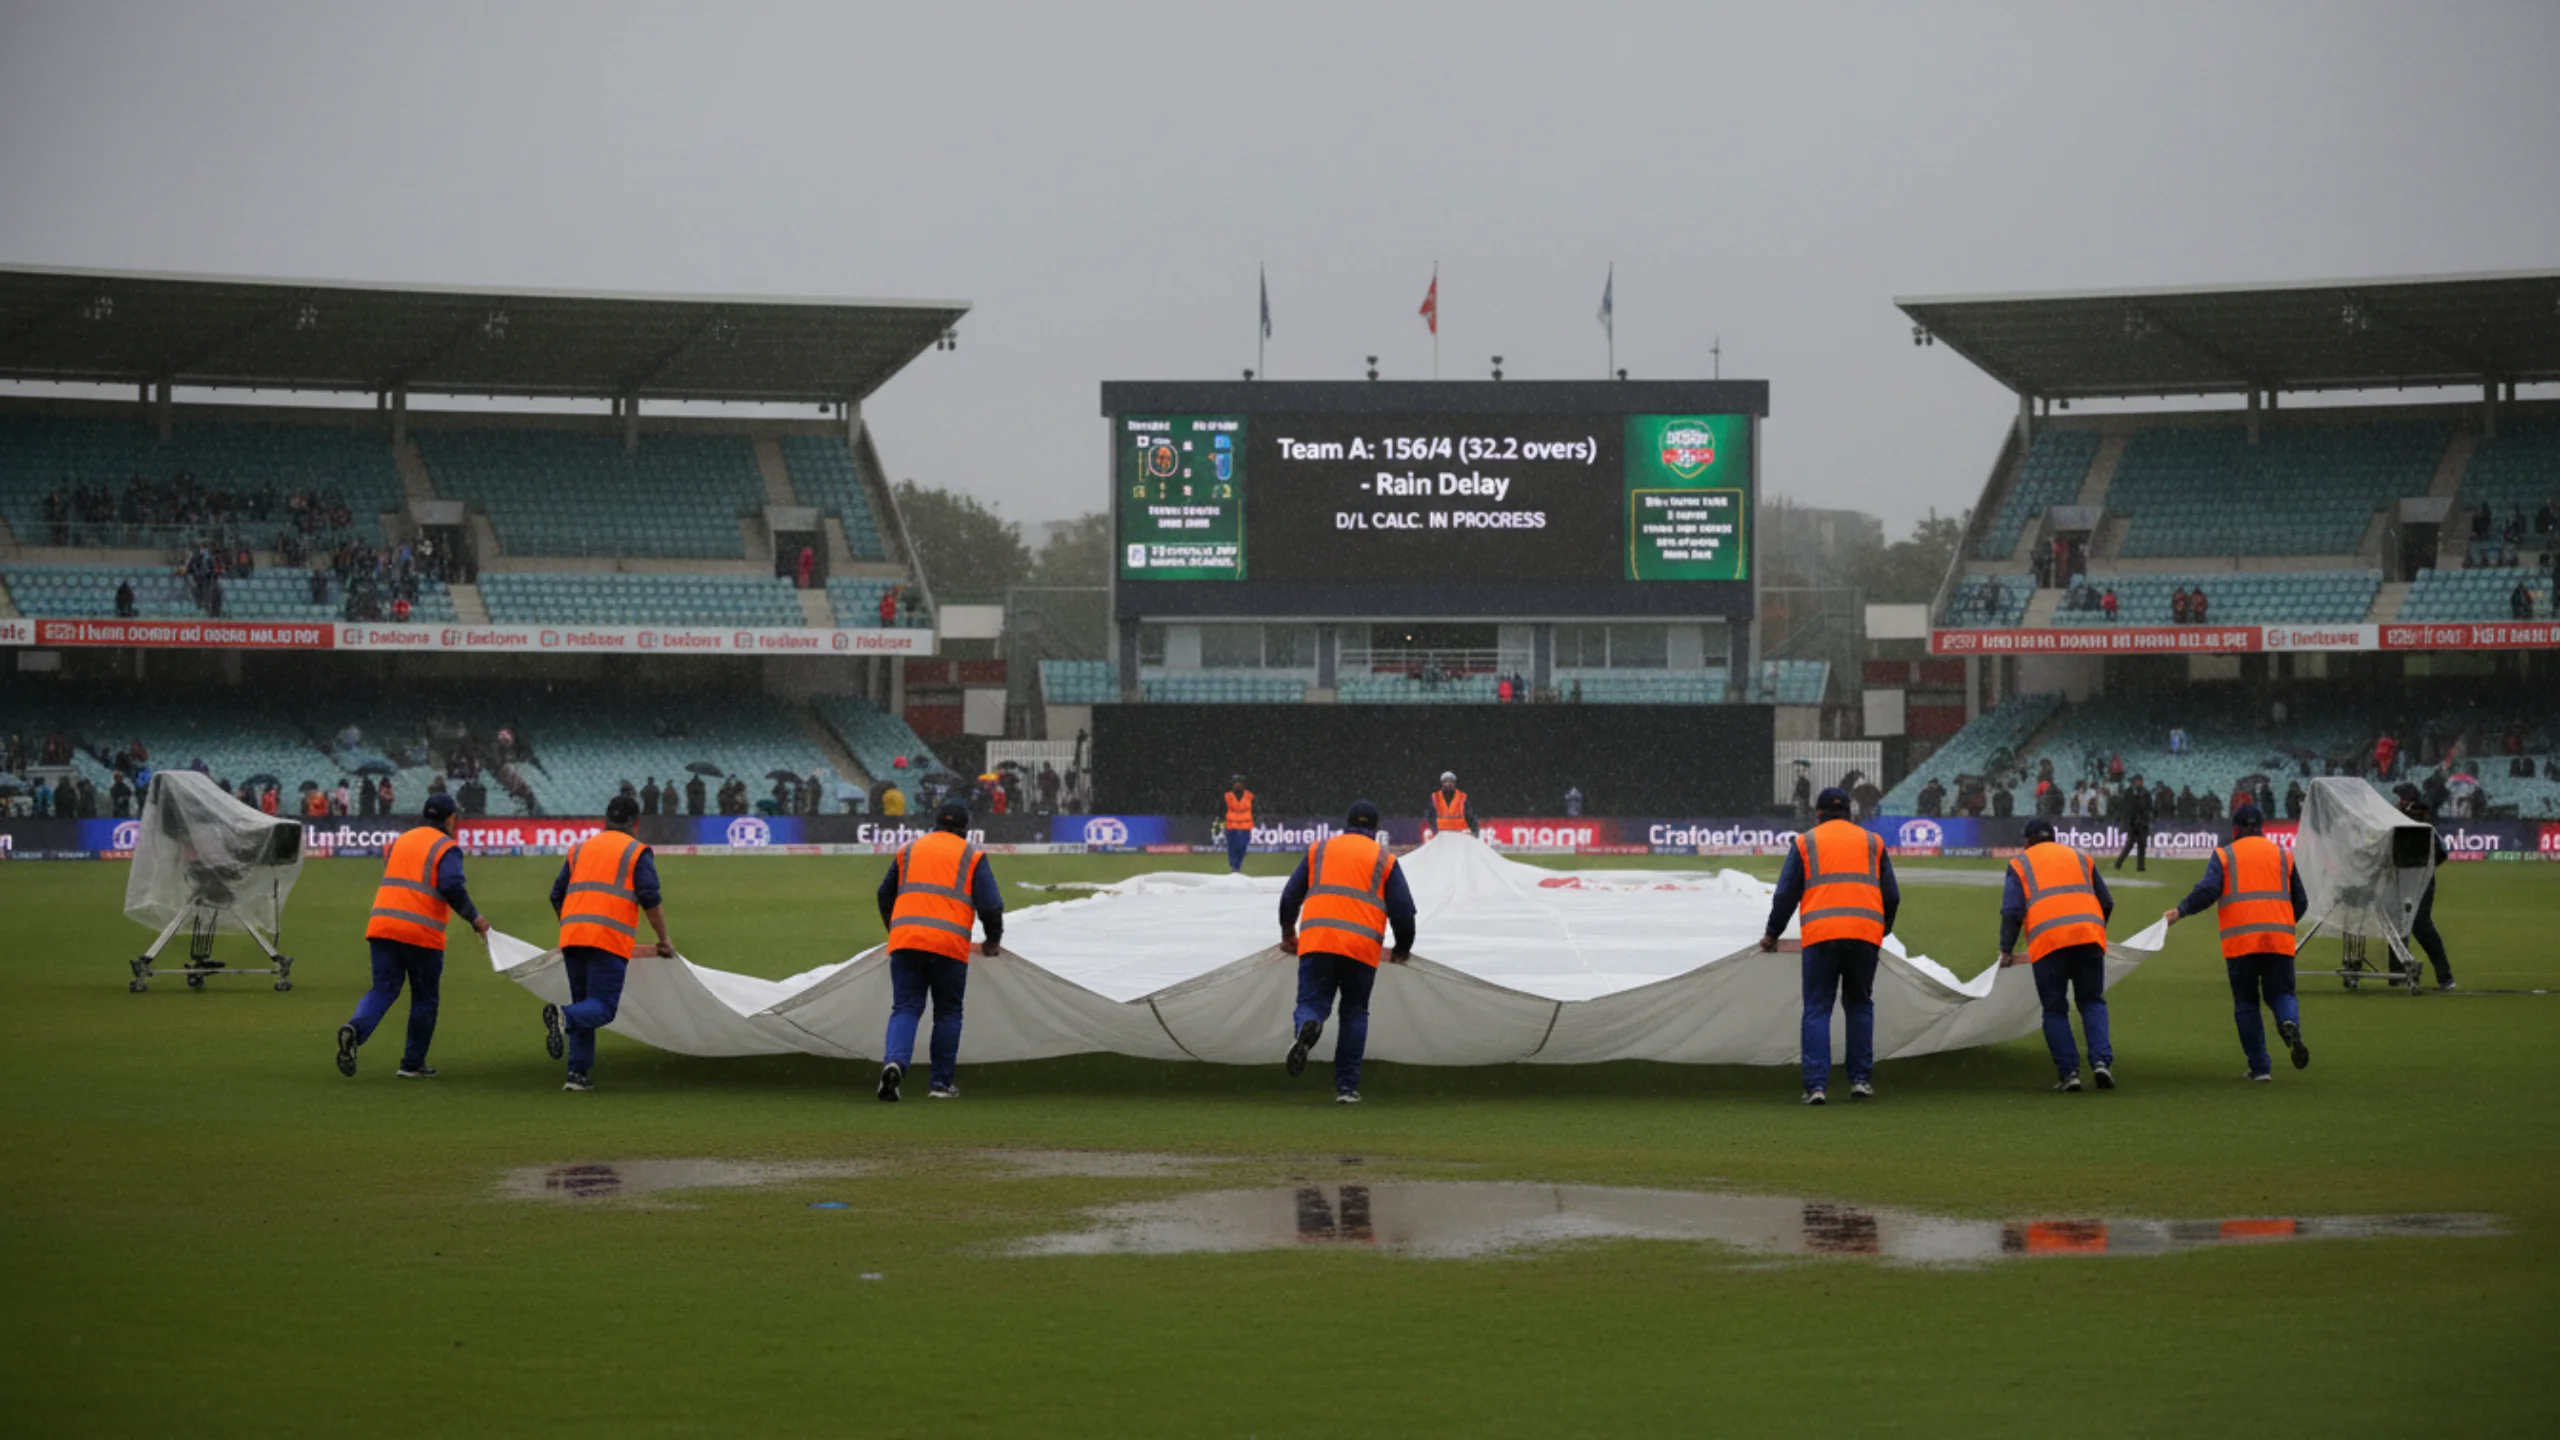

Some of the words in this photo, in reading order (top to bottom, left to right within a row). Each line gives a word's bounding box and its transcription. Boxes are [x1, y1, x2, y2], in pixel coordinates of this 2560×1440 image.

[1276, 437, 1344, 461] Team
[1347, 436, 1375, 460] A:
[1382, 436, 1453, 461] 156/4
[1458, 436, 1519, 465] (32.2
[1522, 435, 1598, 465] overs)
[1376, 471, 1432, 496] Rain
[1438, 470, 1510, 501] Delay
[1335, 511, 1369, 530] D/L
[1371, 511, 1424, 529] CALC.
[1429, 511, 1449, 529] IN
